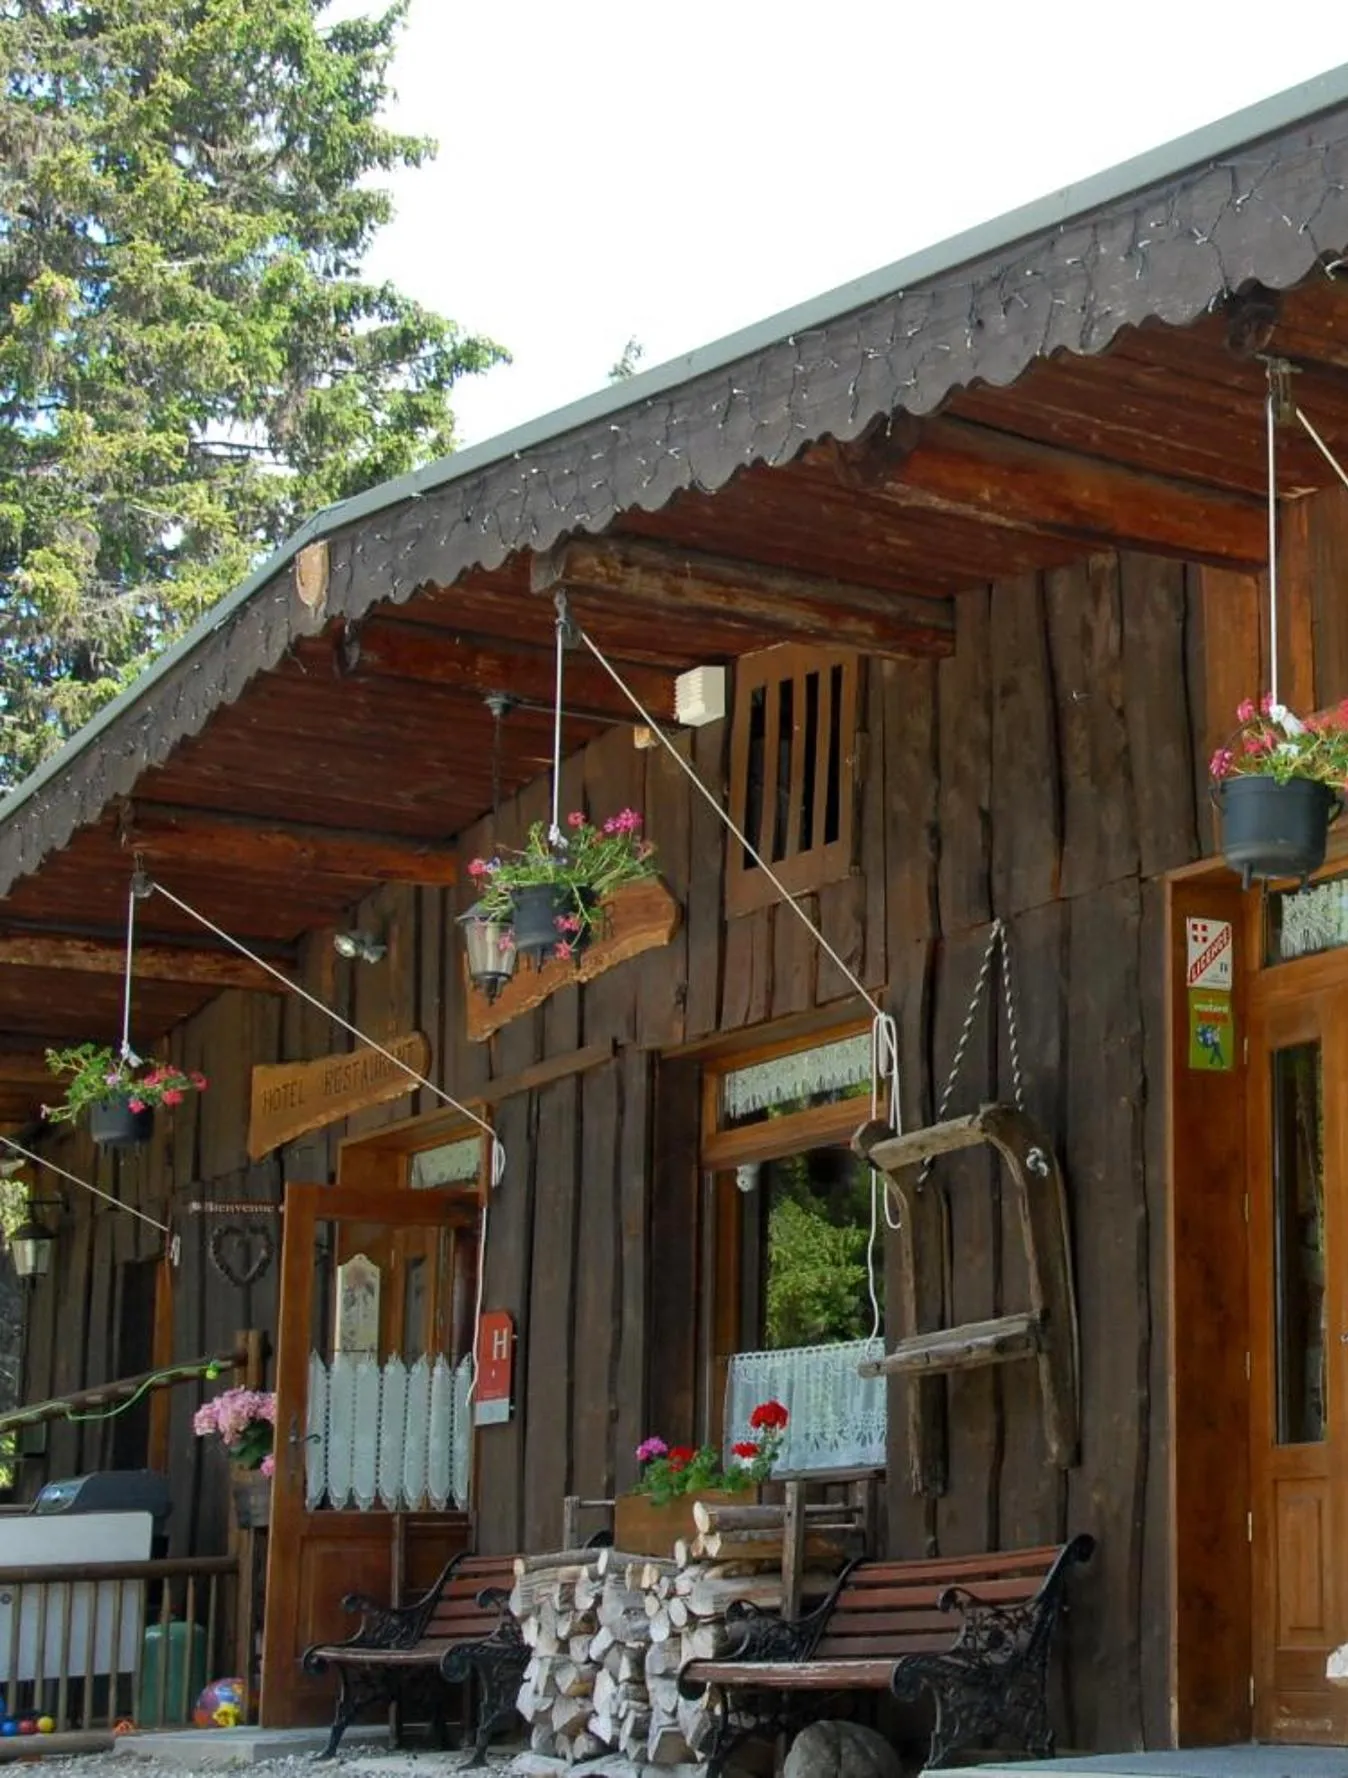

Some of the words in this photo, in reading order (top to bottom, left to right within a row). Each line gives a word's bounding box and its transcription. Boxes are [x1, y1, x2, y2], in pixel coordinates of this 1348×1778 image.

[1190, 925, 1229, 981] LICENCE
[262, 1079, 305, 1115] HOTEL
[205, 1201, 274, 1213] Bienvenue
[493, 1327, 508, 1361] H
